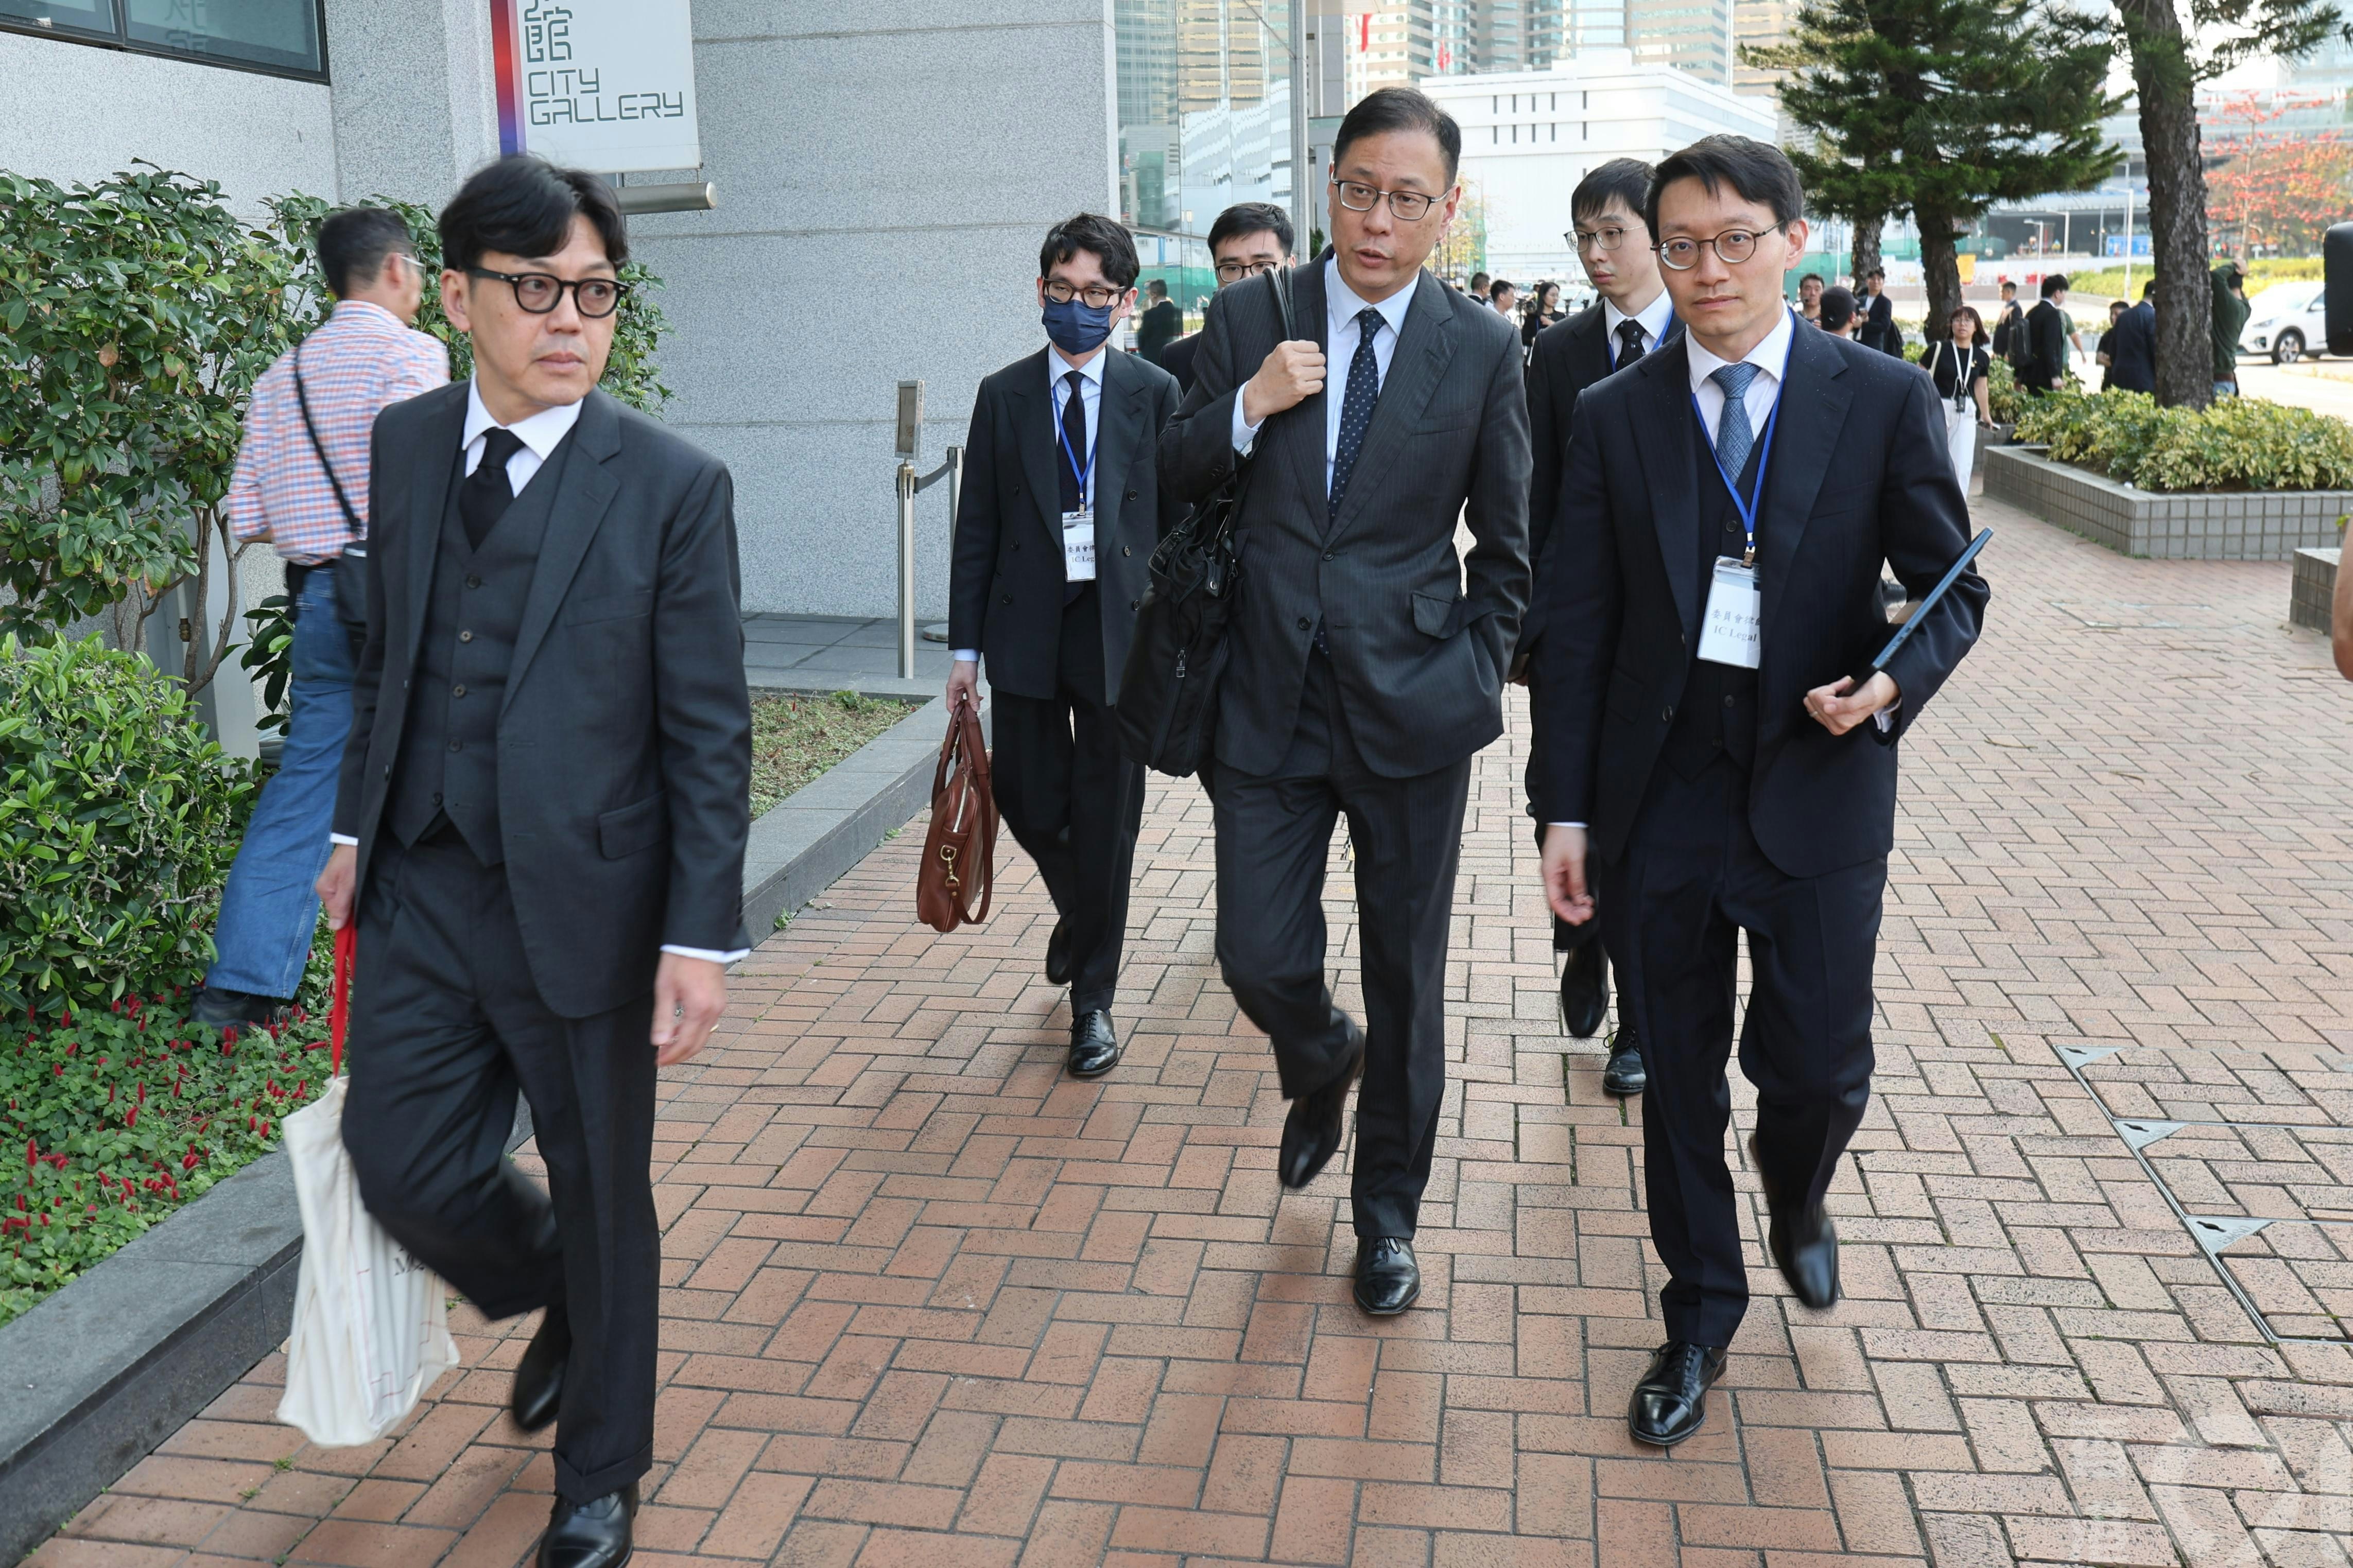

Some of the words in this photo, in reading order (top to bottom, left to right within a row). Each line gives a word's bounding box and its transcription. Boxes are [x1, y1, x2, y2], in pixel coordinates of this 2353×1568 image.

[528, 67, 600, 97] CITY
[530, 91, 684, 126] GALLERY
[1713, 625, 1727, 636] IC
[1729, 629, 1757, 642] Legal
